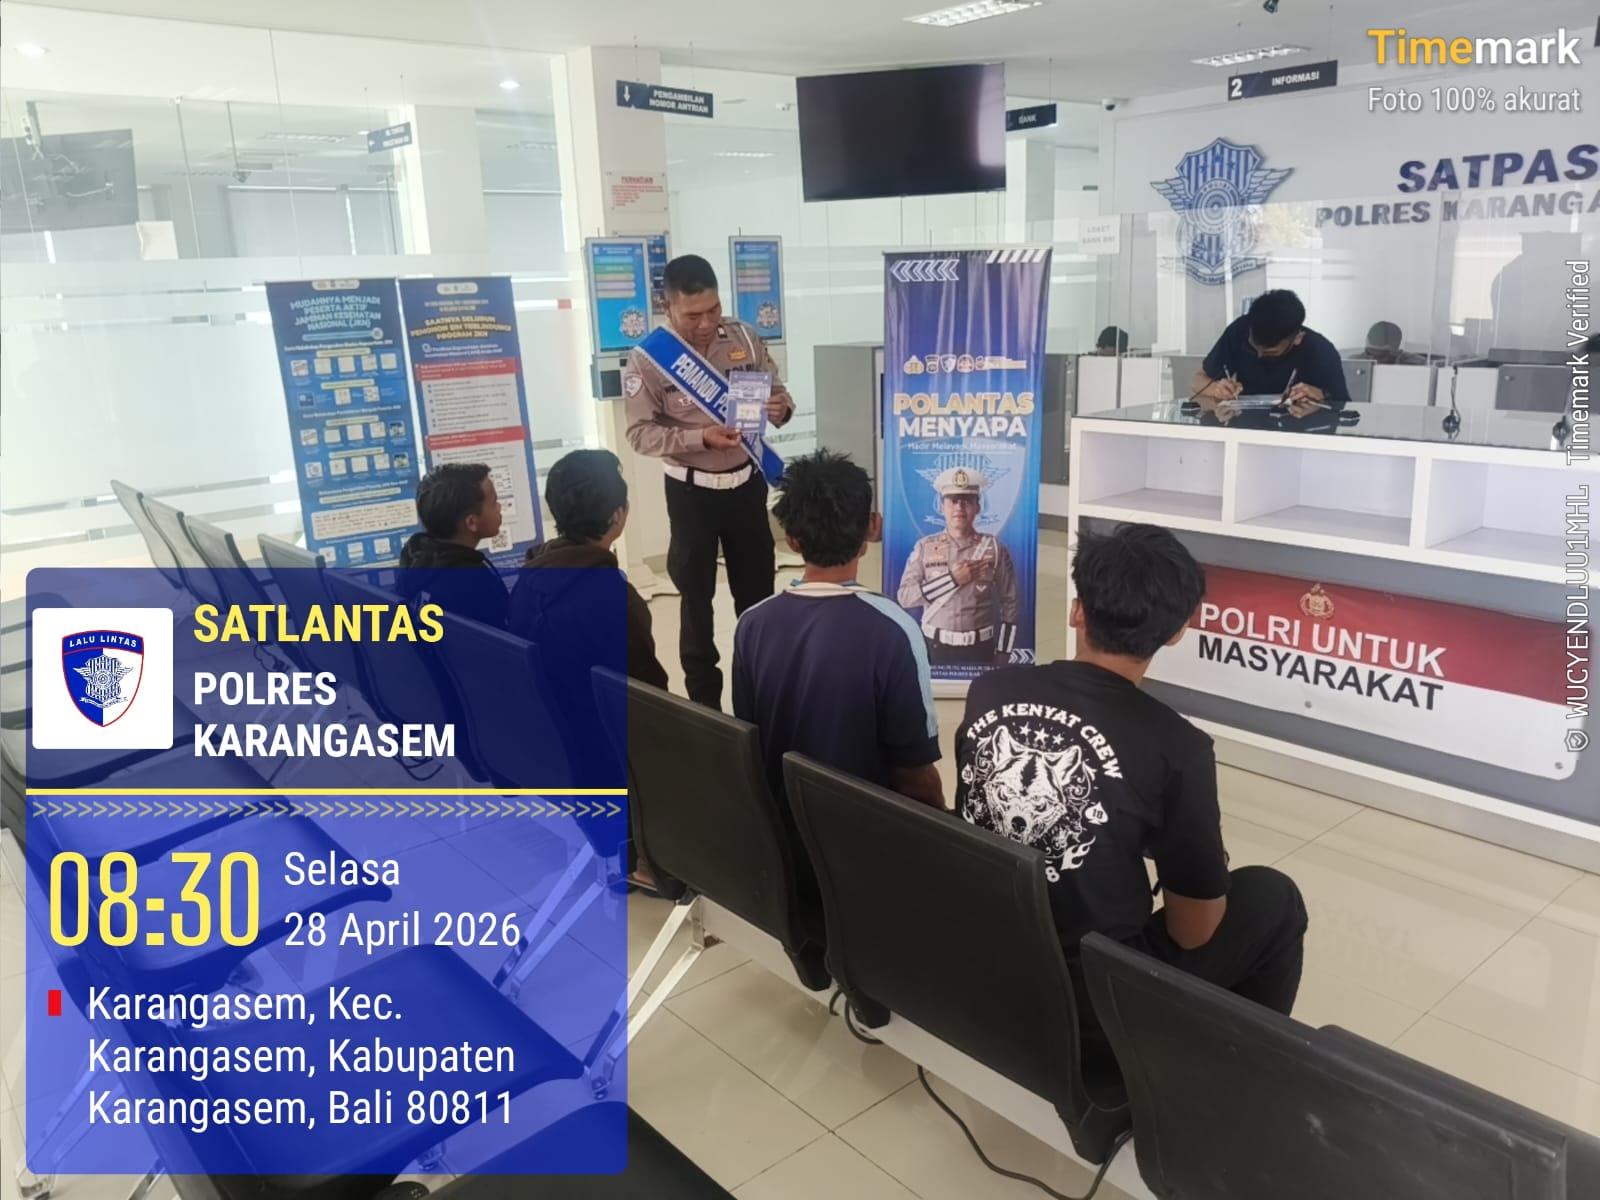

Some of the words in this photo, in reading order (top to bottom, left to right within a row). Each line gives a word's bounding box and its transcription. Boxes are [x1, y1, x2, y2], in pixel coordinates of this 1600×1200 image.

[1231, 78, 1242, 97] 2
[1272, 71, 1320, 87] INFORMASI
[649, 98, 676, 110] NOMOR
[677, 101, 709, 113] ANTRIAN
[653, 89, 704, 104] PENGAMBILAN
[1397, 143, 1600, 193] SATPAS
[1315, 201, 1431, 228] POLRES
[290, 297, 340, 311] MUDAHNYA
[342, 295, 381, 305] MENJADI
[304, 303, 341, 314] PESERTA
[343, 303, 368, 311] AKTIF
[307, 320, 347, 331] NASIONAL
[334, 312, 382, 320] KESEHATAN
[670, 353, 722, 403] PEMANDU
[893, 391, 1035, 416] POLANTAS
[899, 416, 1028, 438] MENYAPA
[1200, 602, 1301, 647] POLRI
[1312, 623, 1447, 678] UNTUK
[1198, 634, 1444, 711] MASYARAKAT
[967, 710, 998, 740] THE
[1002, 703, 1082, 728] KENYAT
[1080, 725, 1123, 779] CREW
